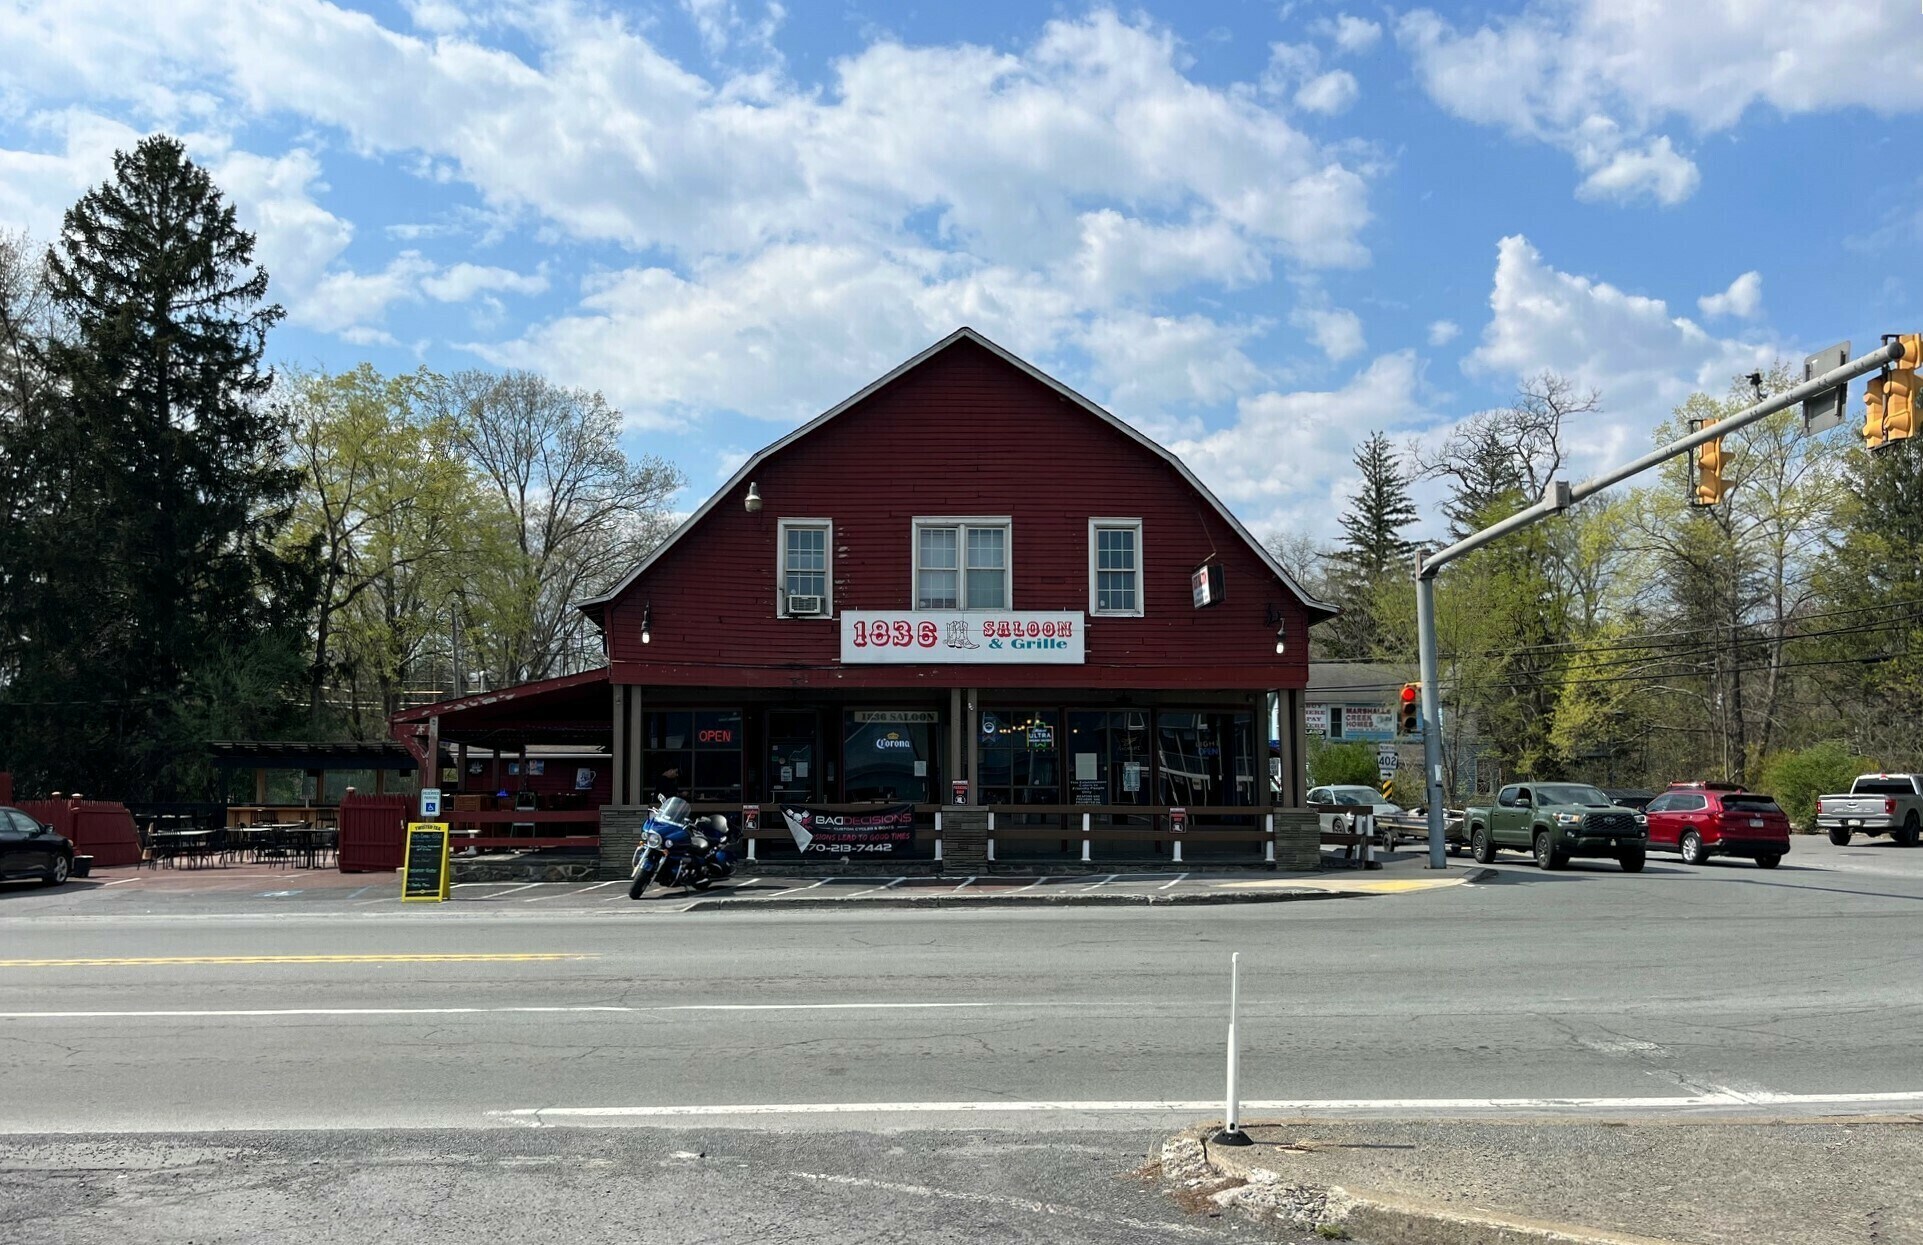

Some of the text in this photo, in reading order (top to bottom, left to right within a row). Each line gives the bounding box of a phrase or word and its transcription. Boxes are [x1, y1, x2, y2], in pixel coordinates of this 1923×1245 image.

[853, 620, 1073, 648] 1836 SALOON
[988, 638, 1068, 649] & Grille
[861, 712, 936, 721] 1836 SALOON
[698, 729, 732, 742] OPEN
[875, 737, 911, 750] Corona
[1378, 756, 1397, 766] 402
[837, 833, 858, 842] LEAD
[858, 833, 868, 842] TO
[869, 832, 890, 842] GOOD
[891, 832, 911, 841] TIMES
[806, 843, 893, 853] 70-213-7442
